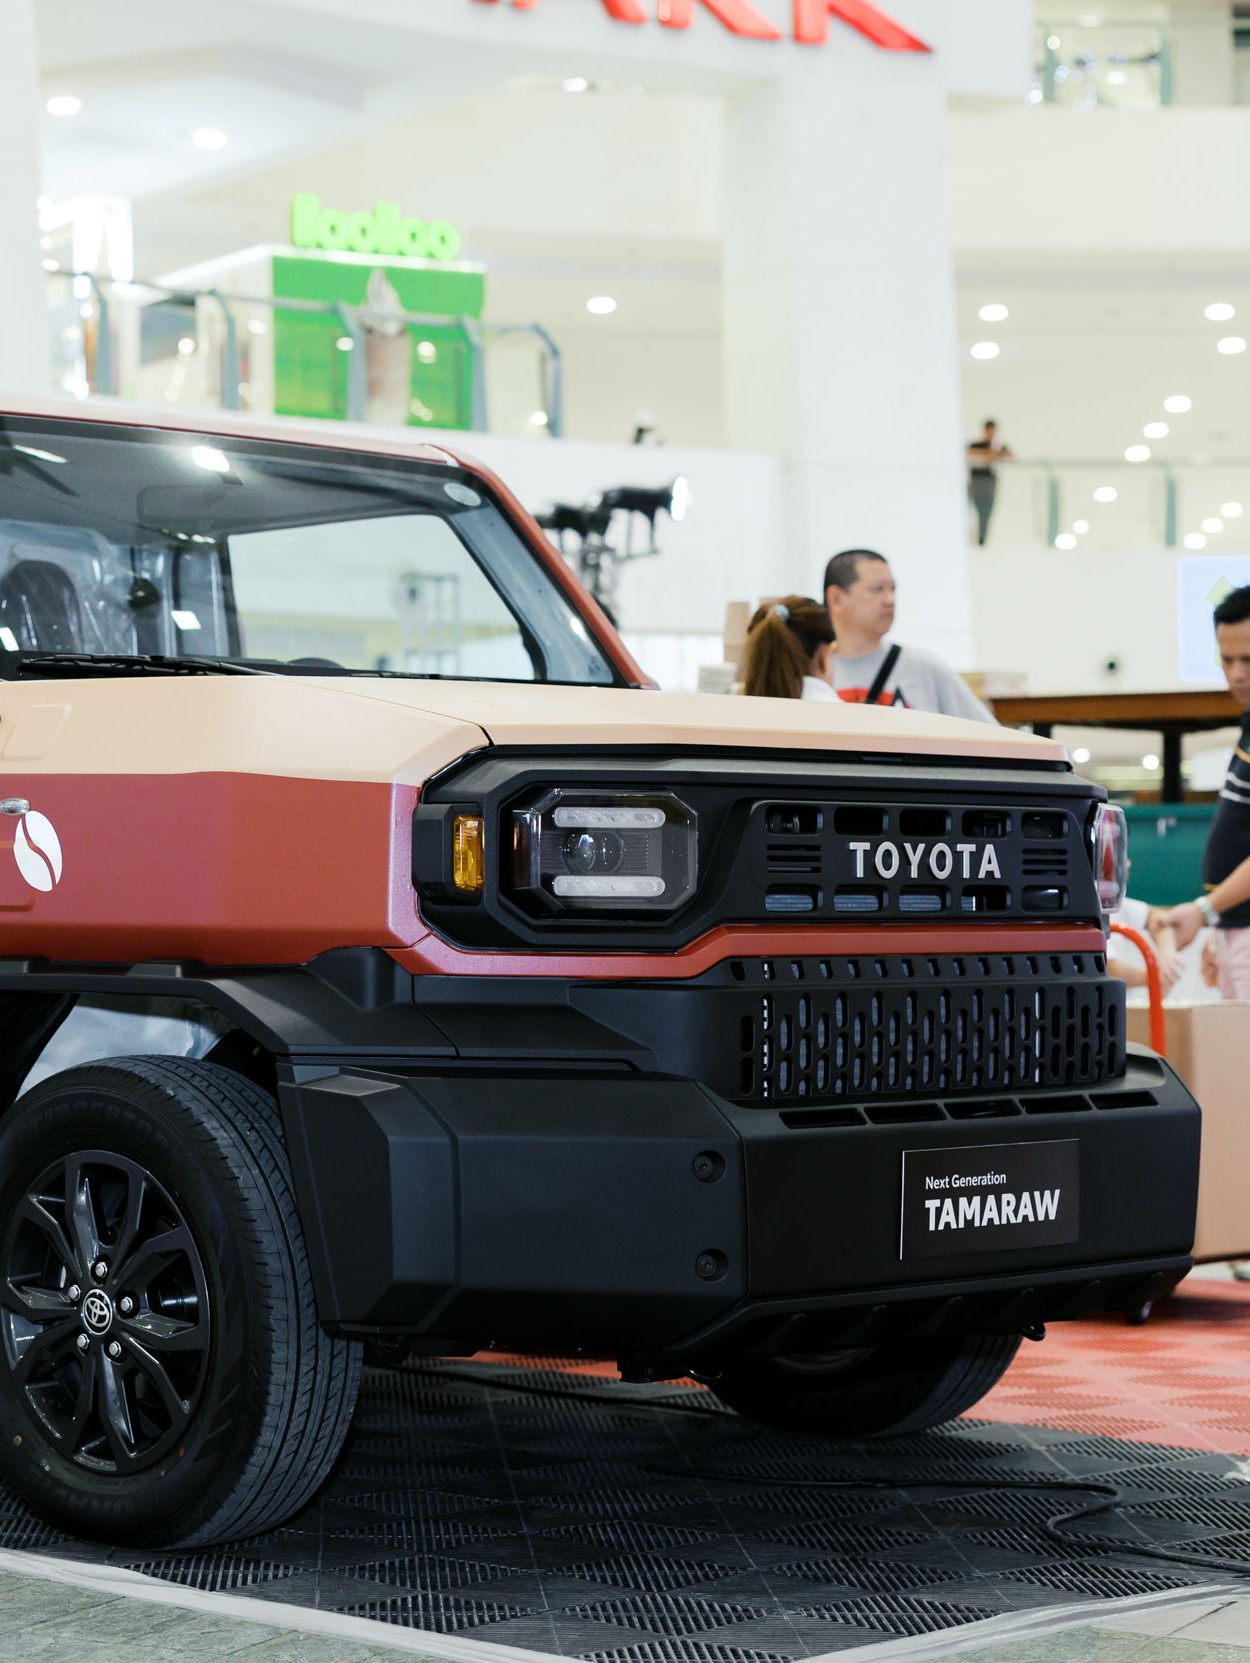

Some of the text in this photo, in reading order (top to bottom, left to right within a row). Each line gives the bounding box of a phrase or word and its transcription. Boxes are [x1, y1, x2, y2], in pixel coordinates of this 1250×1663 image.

[849, 841, 1001, 880] TOYOTA
[925, 1171, 1007, 1190] Next Generation
[924, 1189, 1061, 1231] TAMARAW
